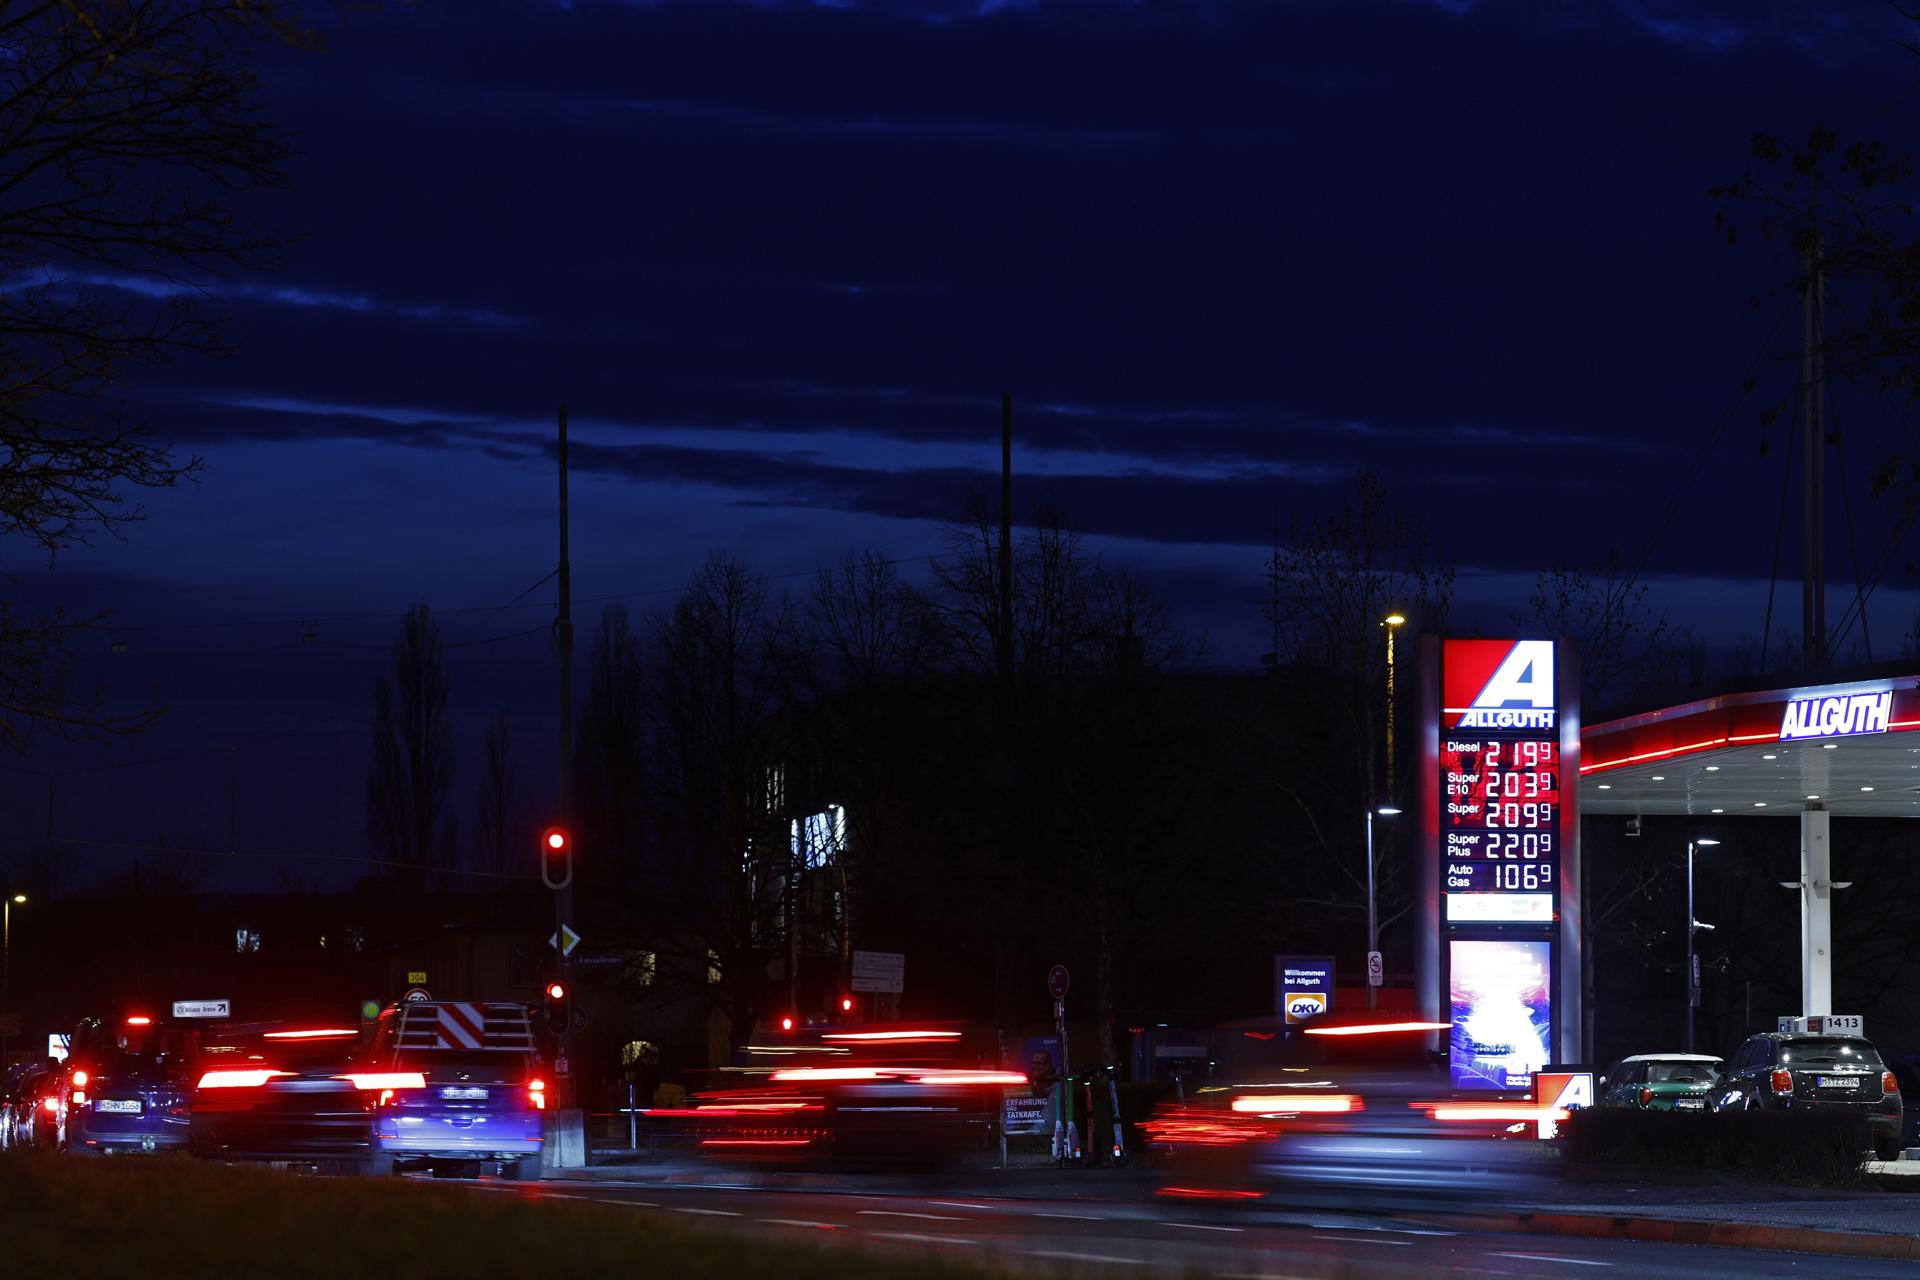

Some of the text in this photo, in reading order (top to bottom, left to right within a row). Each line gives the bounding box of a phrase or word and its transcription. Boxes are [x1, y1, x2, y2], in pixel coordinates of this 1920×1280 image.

[1459, 712, 1553, 728] ALLGUTH
[1780, 693, 1889, 739] ALLGUTH
[1448, 742, 1480, 752] Diesel
[1448, 772, 1480, 784] Super
[1448, 785, 1469, 795] E10
[1448, 803, 1480, 815] Super
[1448, 834, 1480, 845] Super
[1448, 846, 1471, 856] Plus
[1448, 865, 1473, 875] Auto
[1448, 877, 1470, 887] Gas
[1284, 969, 1326, 977] Willkommen
[1296, 978, 1320, 986] Allguth
[1291, 1004, 1320, 1013] DKV
[1827, 1018, 1858, 1028] 14 13
[1006, 1111, 1042, 1119] TATKRAFT.
